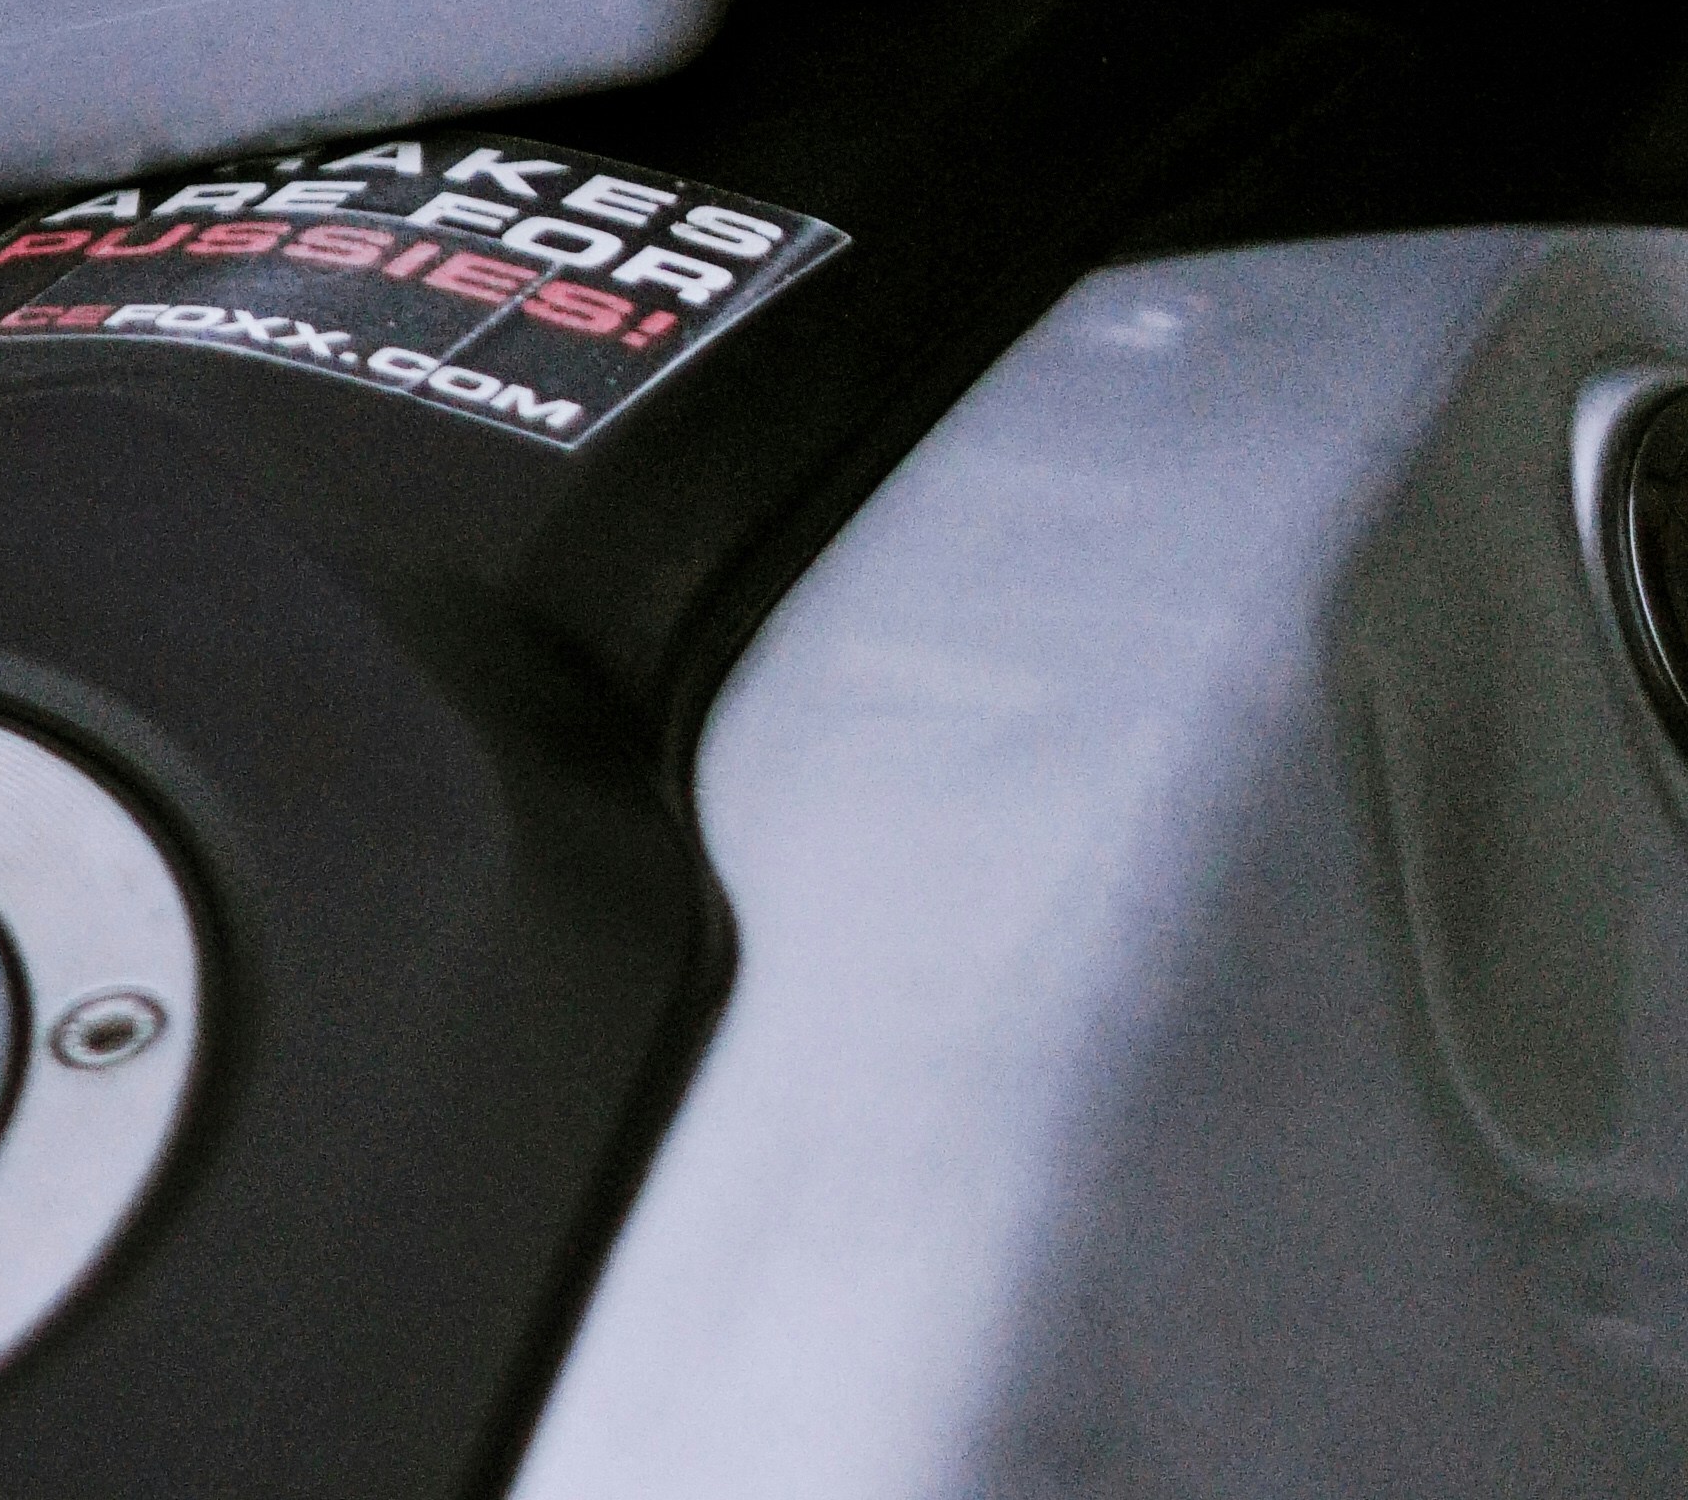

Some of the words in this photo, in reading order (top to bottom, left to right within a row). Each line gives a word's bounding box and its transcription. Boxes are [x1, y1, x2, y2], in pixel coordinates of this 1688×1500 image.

[39, 179, 369, 224] ARE
[406, 190, 736, 306] FOR
[277, 139, 784, 258] AKES
